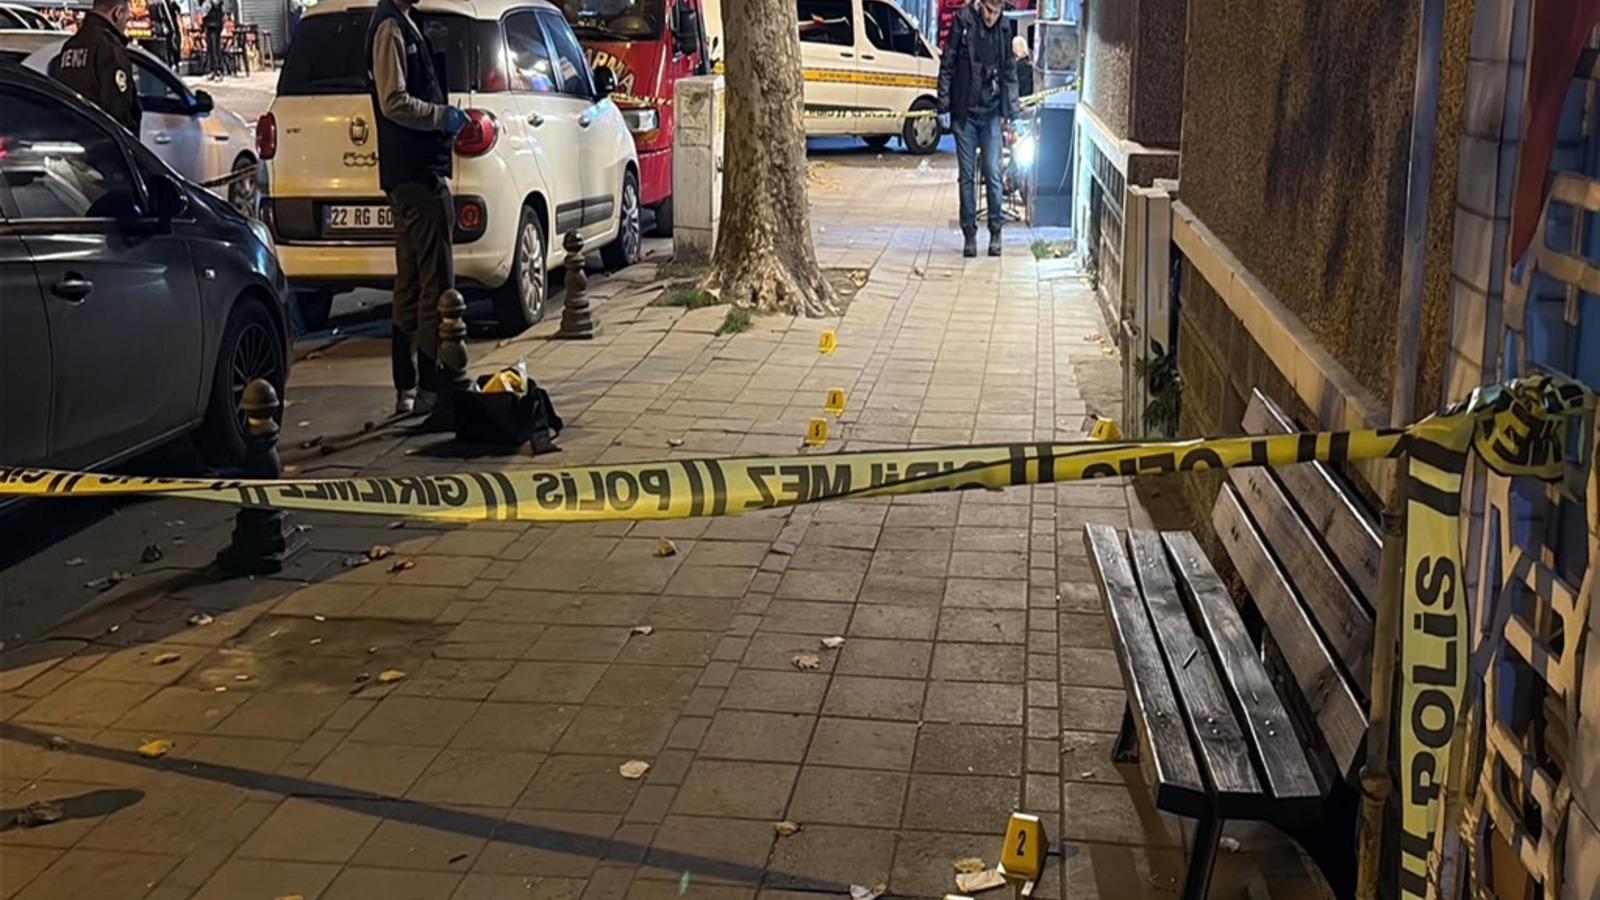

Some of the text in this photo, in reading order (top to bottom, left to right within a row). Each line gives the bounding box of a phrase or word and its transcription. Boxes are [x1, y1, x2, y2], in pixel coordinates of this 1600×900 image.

[331, 208, 348, 226] 22
[354, 208, 371, 226] RG
[1410, 554, 1458, 807] POLİS
[1016, 829, 1027, 857] 2
